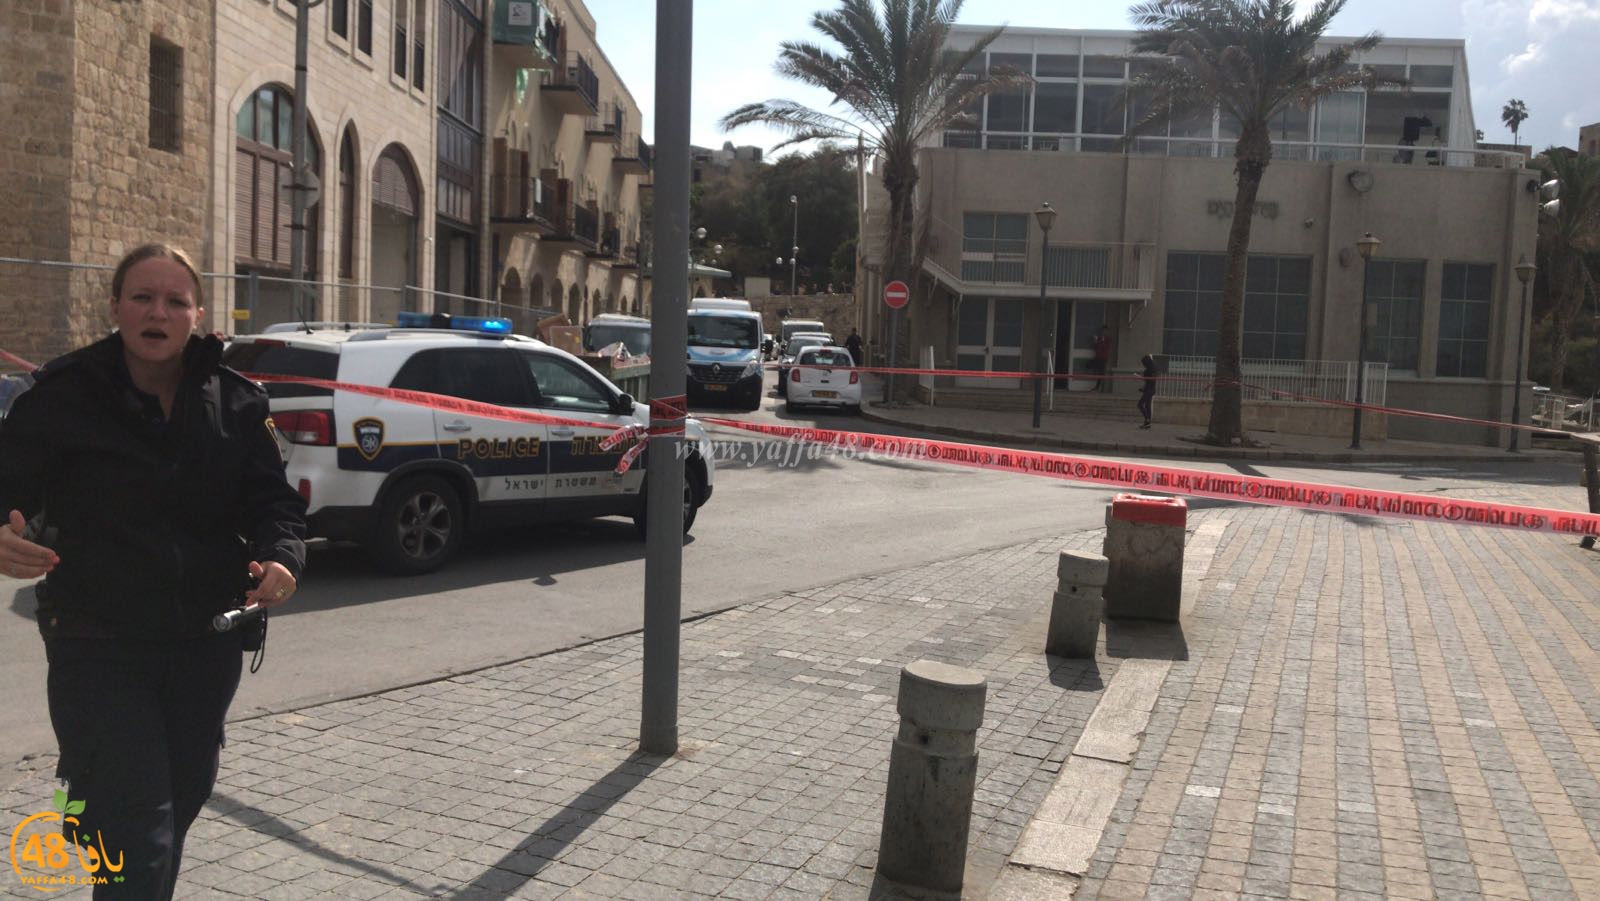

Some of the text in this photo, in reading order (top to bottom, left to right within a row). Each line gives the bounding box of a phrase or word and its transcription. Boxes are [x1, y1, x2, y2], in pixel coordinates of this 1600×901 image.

[457, 437, 540, 460] POLICE
[504, 476, 597, 490] משטרת ישראל
